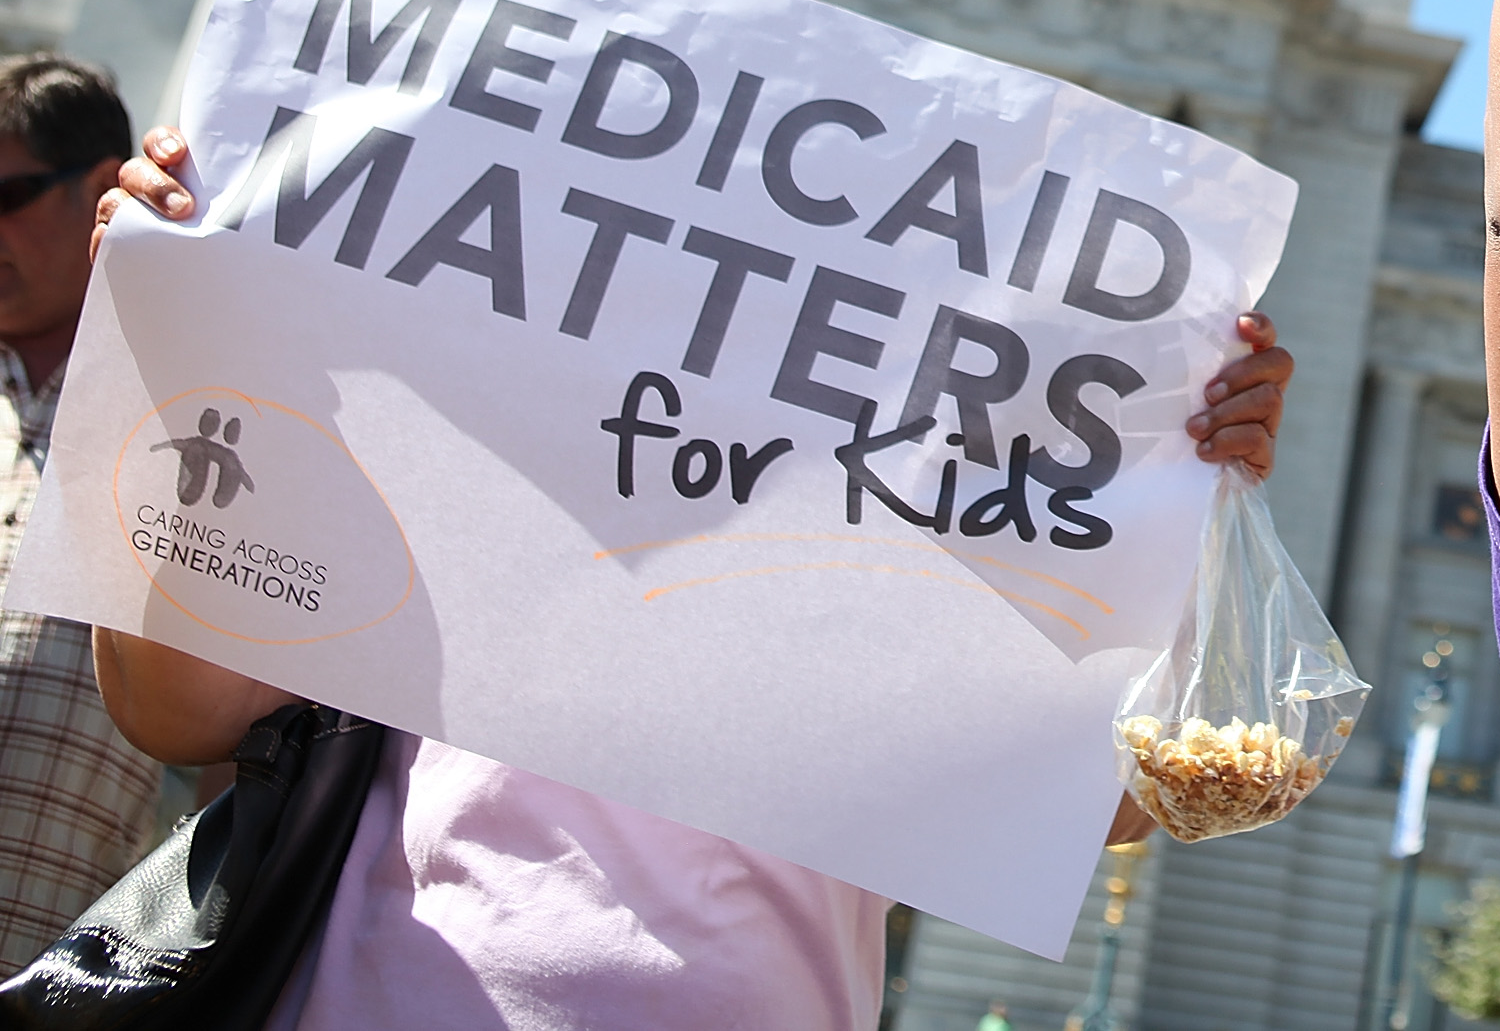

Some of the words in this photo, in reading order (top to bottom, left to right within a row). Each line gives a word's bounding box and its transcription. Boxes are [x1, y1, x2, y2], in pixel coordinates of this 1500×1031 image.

[215, 106, 1147, 494] MATTERS
[601, 370, 793, 505] for
[834, 400, 1115, 551] Kids
[131, 529, 322, 612] GENERATIONS
[137, 504, 226, 549] CARING
[232, 539, 328, 585] ACROSS
